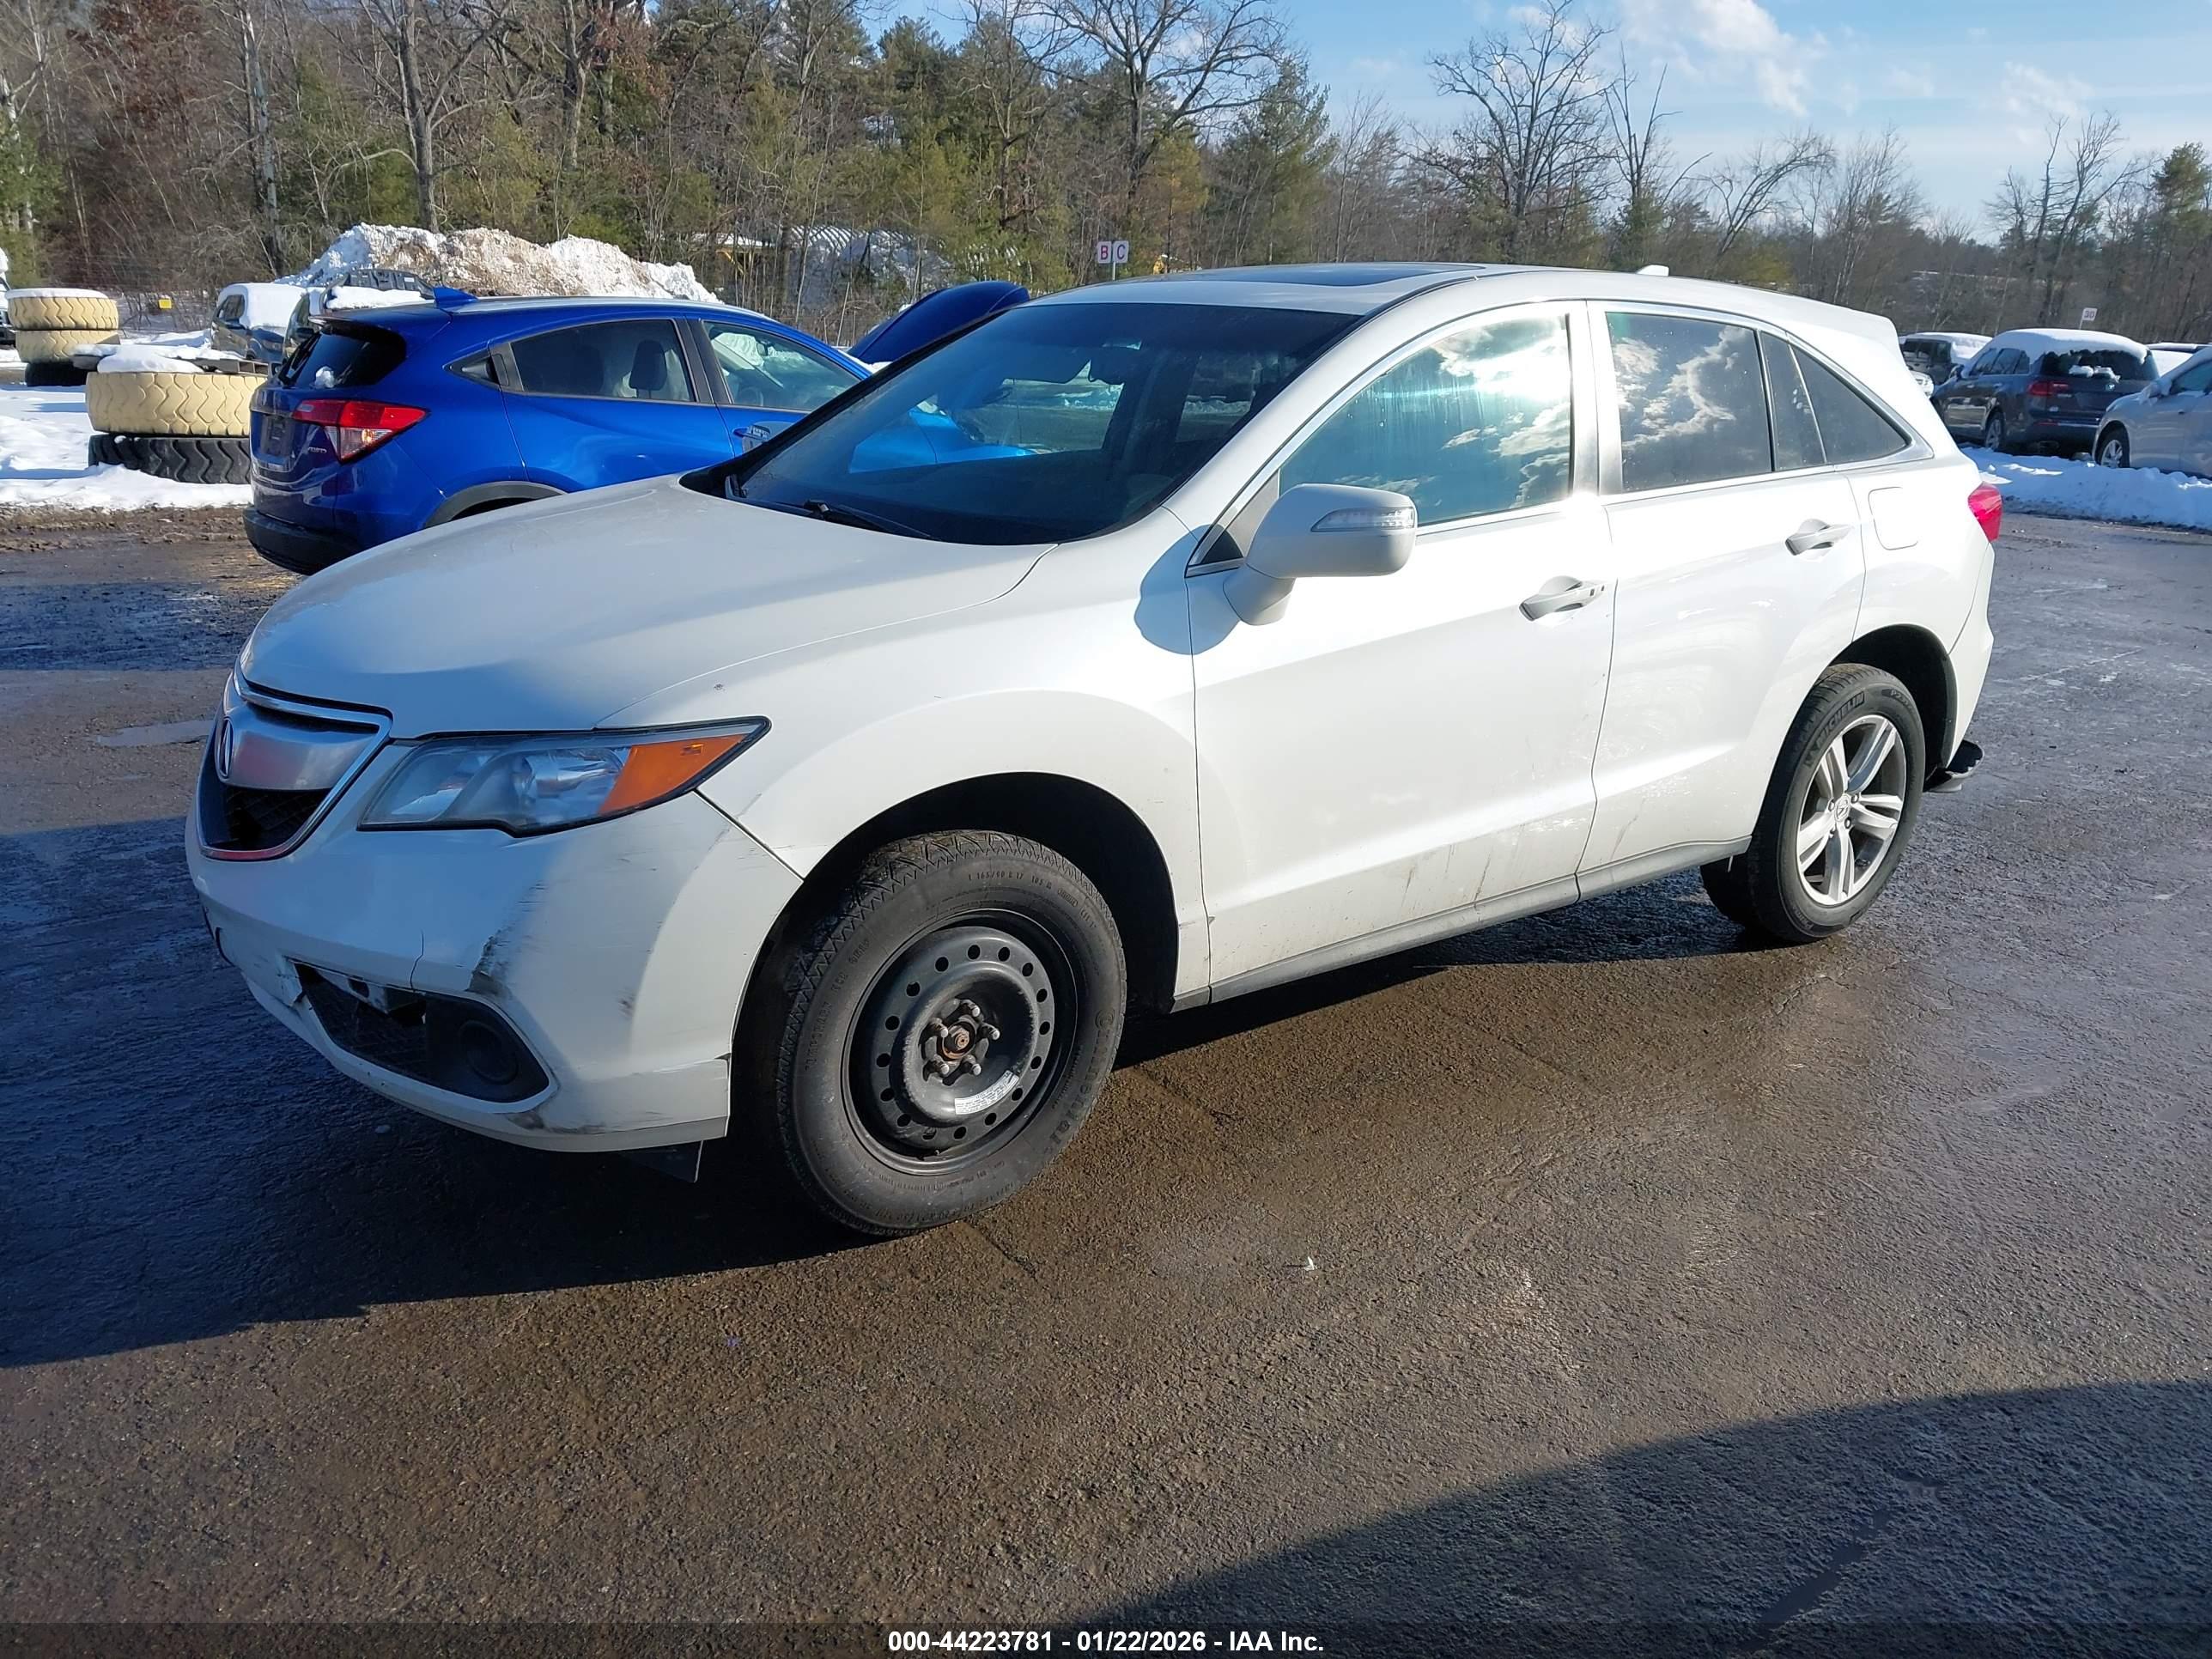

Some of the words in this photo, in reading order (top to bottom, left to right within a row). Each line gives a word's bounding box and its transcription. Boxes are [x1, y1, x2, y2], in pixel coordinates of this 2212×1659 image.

[1100, 245, 1109, 260] B
[1116, 244, 1126, 260] C
[1814, 692, 1865, 749] MICHELIN
